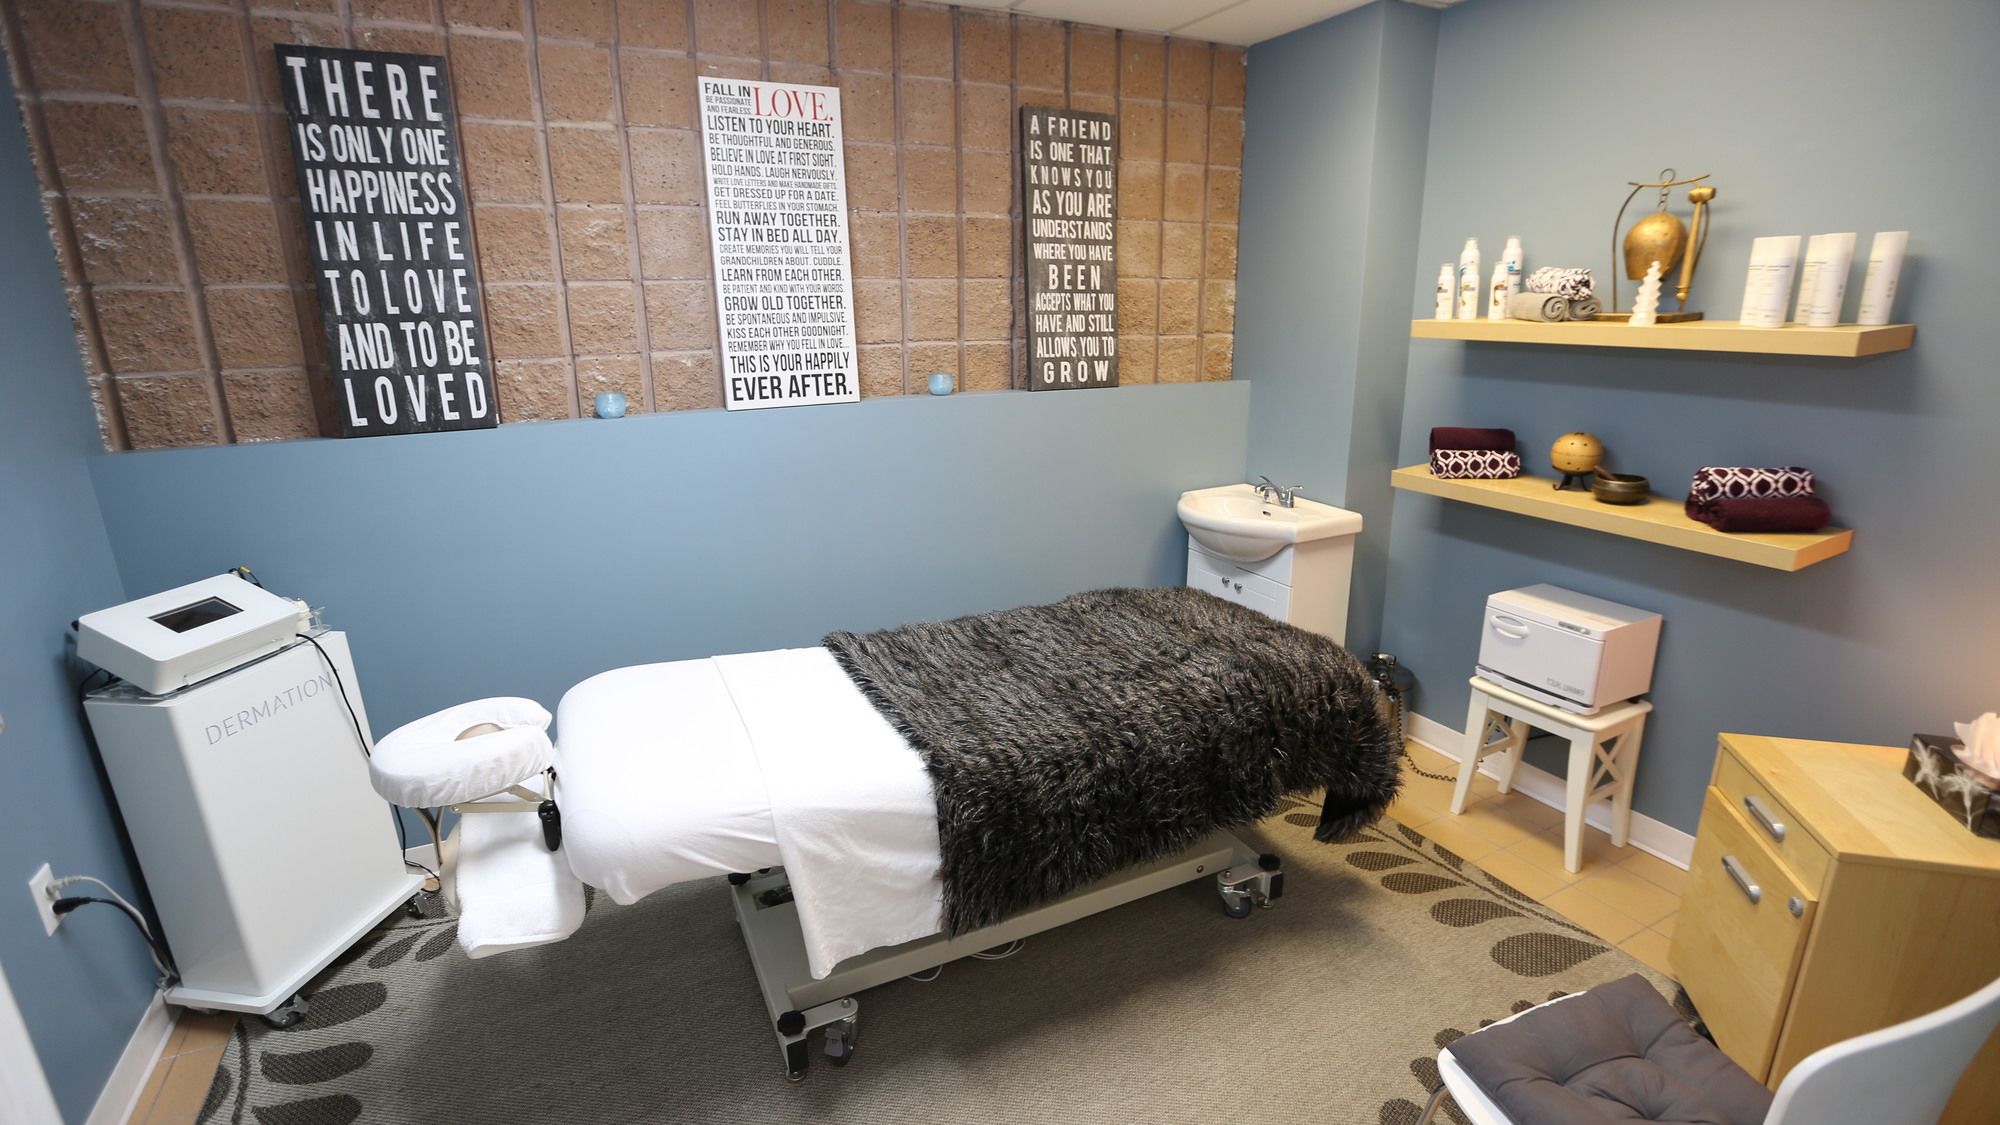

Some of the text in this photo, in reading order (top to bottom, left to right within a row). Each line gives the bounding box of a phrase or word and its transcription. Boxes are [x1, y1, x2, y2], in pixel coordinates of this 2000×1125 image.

[285, 56, 443, 121] THERE
[705, 83, 833, 121] FALL IN LOVE.
[715, 96, 751, 106] PASSIONATE
[708, 115, 835, 138] LISTEN TO YOUR HEART.
[1030, 115, 1111, 140] A FRIEND
[298, 123, 449, 165] IS ONLY ONE
[709, 133, 835, 151] BE THOUGHTFUL AND GENEROUS.
[1030, 140, 1111, 165] IS ONE THAT
[711, 148, 837, 167] BELIEVE IN LOVE AT FIRST SIGHT.
[712, 164, 837, 181] HOLD HANDS. LAUGH NERVOUSLY.
[1030, 165, 1111, 189] KNOWS YOU
[306, 169, 457, 215] HAPPINESS
[715, 187, 839, 201] GET DRESSED UP FOR A DATE.
[715, 200, 731, 208] FEEL
[734, 201, 777, 210] BUTTERFLIES
[788, 203, 804, 211] YOUR
[806, 203, 839, 212] STOMACH.
[1033, 189, 1112, 217] AS YOU ARE
[717, 211, 840, 227] RUN AWAY TOGETHER.
[1033, 219, 1113, 240] UNDERSTANDS
[315, 221, 464, 261] IN LIFE
[719, 228, 842, 243] STAY IN BED ALL DAY.
[720, 245, 842, 255] CREATE MEMORIES YOU WILL TELL YOUR
[721, 256, 843, 265] GRANDCHILDREN ABOUT. CUDDLE.
[1034, 243, 1112, 260] WHERE YOU HAVE
[722, 269, 844, 281] LEARN FROM EACH OTHER.
[1048, 264, 1100, 290] BEEN
[324, 269, 472, 315] TO LOVE
[723, 284, 845, 293] BE PATIENT AND KIND WITH YOUR WORDS.
[725, 295, 846, 311] GROW OLD TOGETHER.
[1036, 293, 1114, 311] ACCEPTS WHAT YOU
[726, 312, 847, 325] BE SPONTANEOUS AND IMPULSIVE.
[1036, 314, 1114, 332] HAVE AND STILL
[727, 326, 848, 338] KISS EACH OTHER GOODNIGHT.
[339, 320, 480, 371] AND TO BE
[729, 338, 849, 352] REMEMBER WHY YOU FELL IN LOVE...
[1037, 336, 1114, 358] ALLOWS YOU TO
[730, 352, 849, 374] THIS IS YOUR HAPPILY
[1044, 361, 1108, 383] GROW
[732, 373, 852, 401] EVER AFTER.
[344, 372, 488, 427] LOVED
[205, 671, 333, 745] DERMATION
